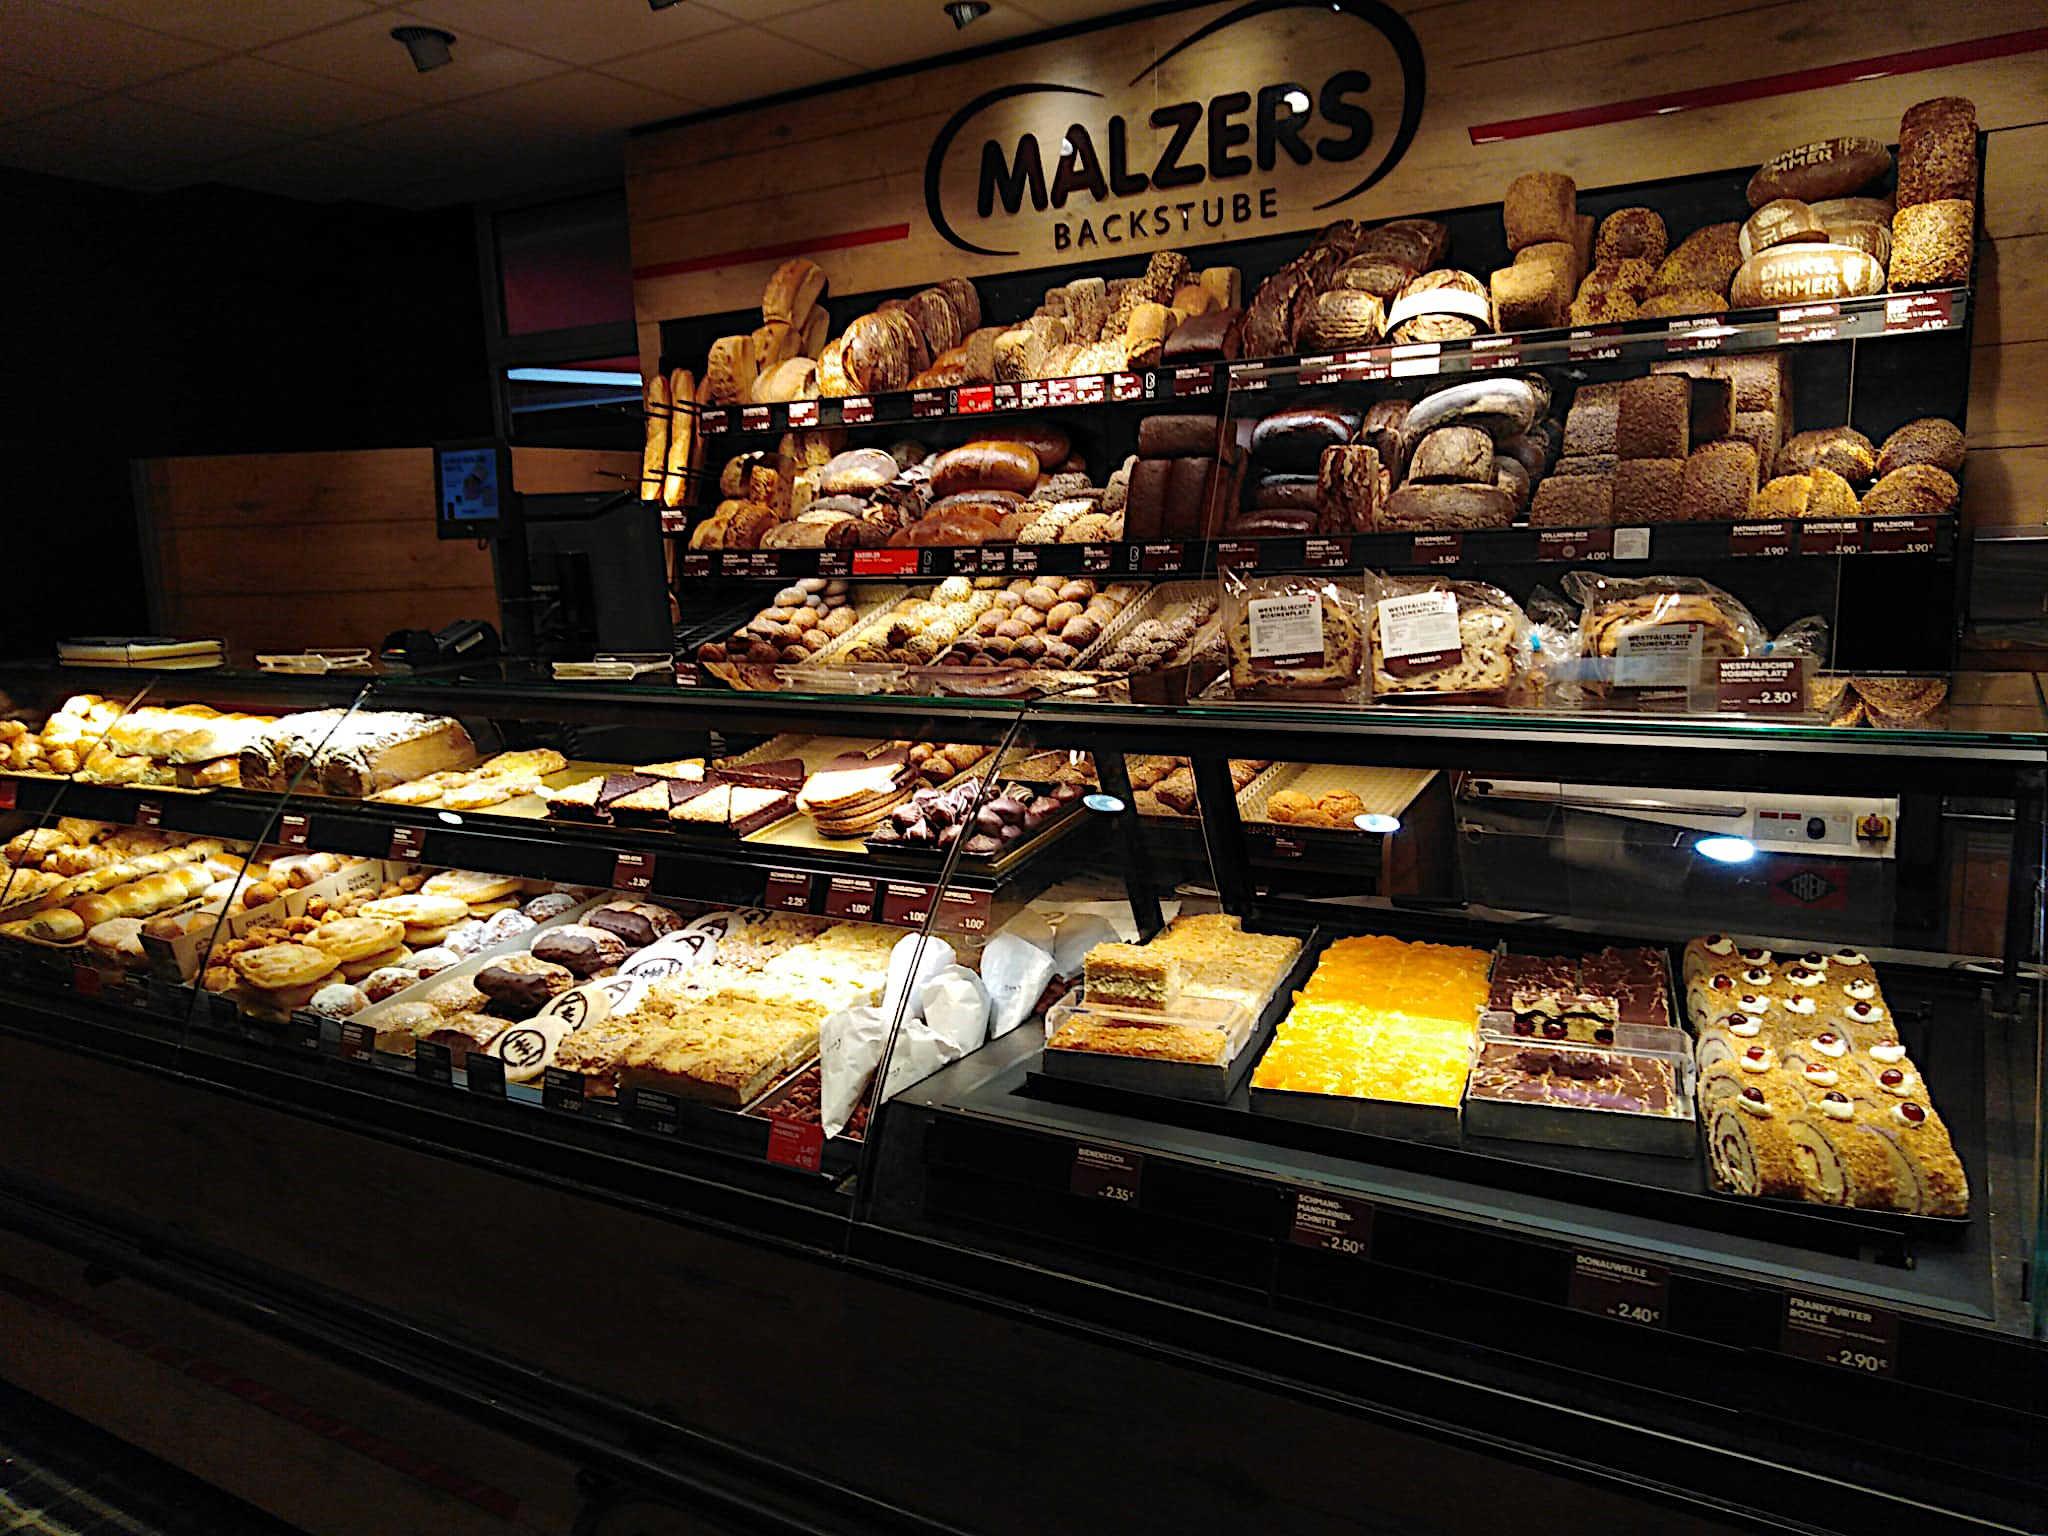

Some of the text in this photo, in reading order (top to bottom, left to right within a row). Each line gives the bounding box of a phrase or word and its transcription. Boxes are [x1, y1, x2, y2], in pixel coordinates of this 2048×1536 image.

[977, 70, 1374, 218] MALZERS
[1054, 187, 1279, 250] BACKSTUBE
[1761, 256, 1839, 281] DINKEL
[1720, 661, 1794, 670] WESTFÄLISCHER
[1720, 669, 1788, 678] ROSINENPLATZ
[1760, 690, 1798, 704] 2.30€
[1295, 1211, 1337, 1229] SCHNITTE
[1575, 1254, 1649, 1279] DONAUWELLE
[1617, 1302, 1661, 1324] 2.40€
[1788, 1296, 1873, 1324] FRANKFURTER
[1788, 1308, 1828, 1325] ROLLE
[1838, 1349, 1889, 1373] 2.90€
